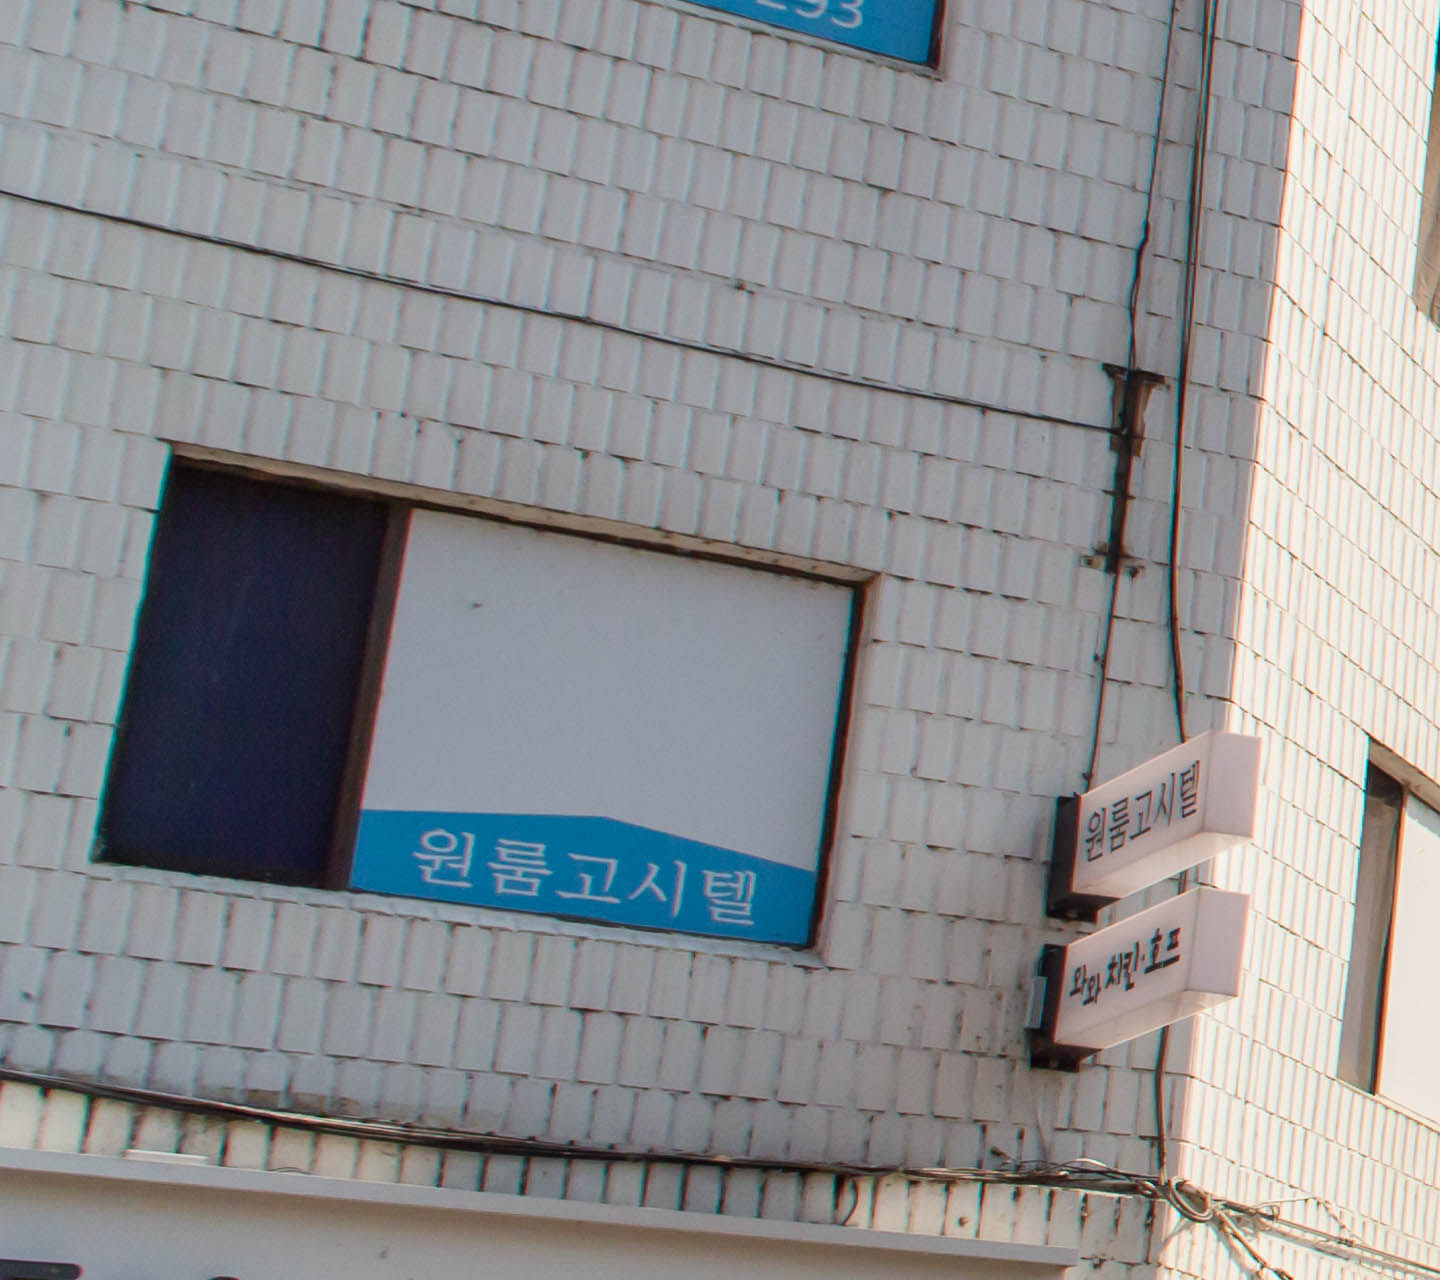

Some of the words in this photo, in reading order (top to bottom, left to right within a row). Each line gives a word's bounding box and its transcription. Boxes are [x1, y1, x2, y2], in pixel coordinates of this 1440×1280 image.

[1085, 760, 1200, 862] 원룸고시텔
[412, 826, 757, 928] 원룸고시텔
[1069, 964, 1101, 1006] 와와
